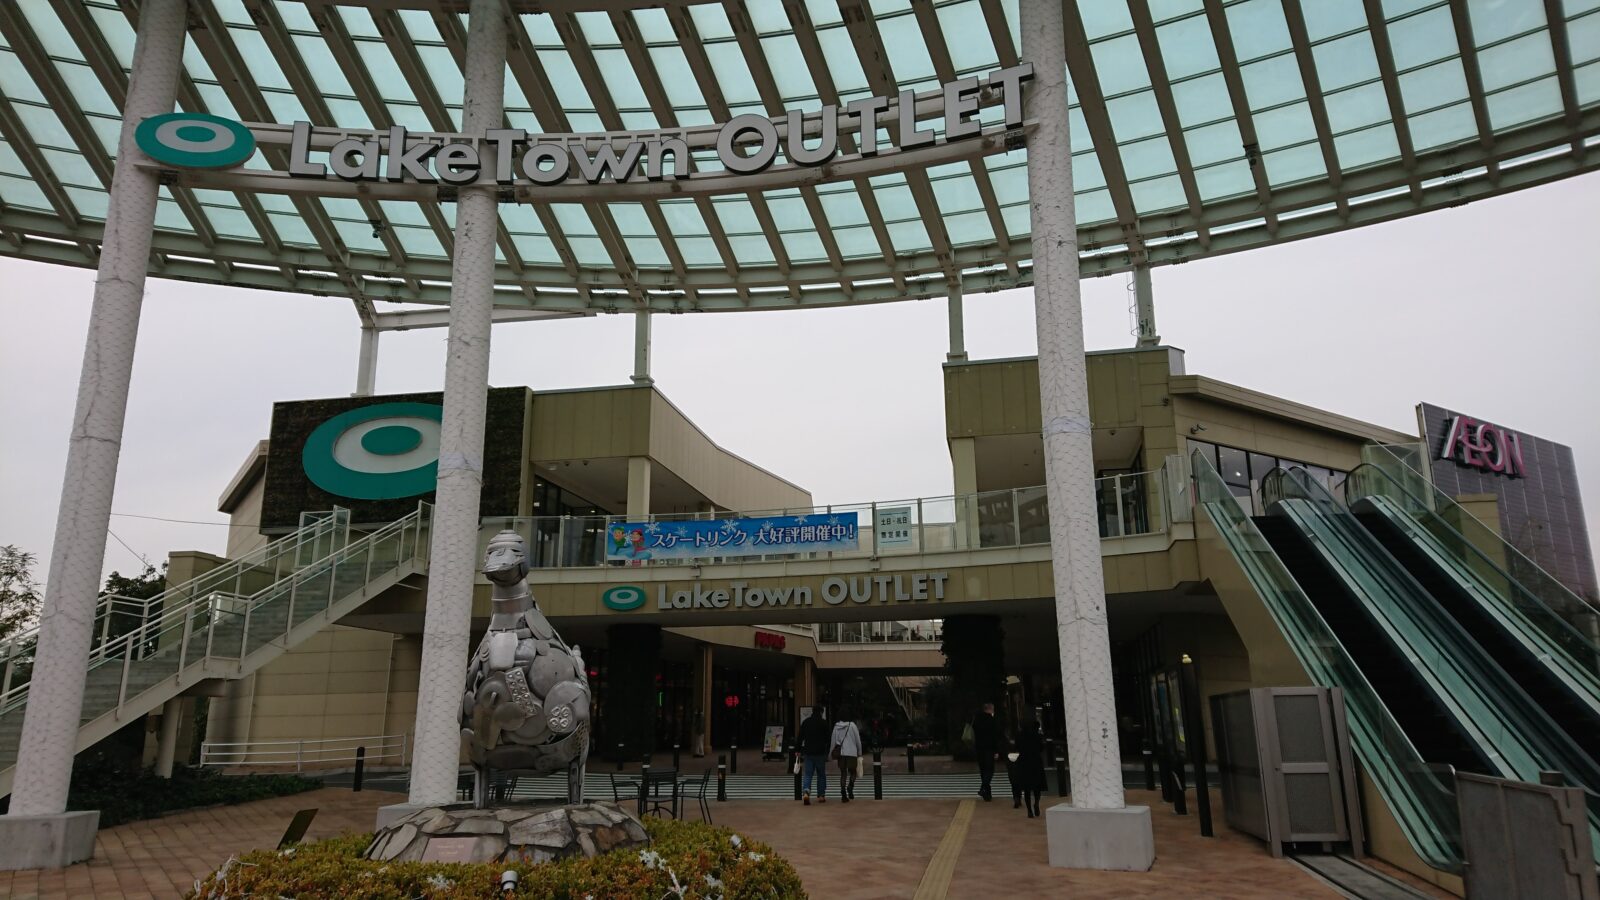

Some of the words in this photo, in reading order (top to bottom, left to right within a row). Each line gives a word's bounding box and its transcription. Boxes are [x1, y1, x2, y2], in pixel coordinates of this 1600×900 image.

[289, 121, 691, 186] LakeTown
[716, 62, 1035, 176] OUTLET
[651, 529, 749, 548] スケートリンク
[657, 581, 813, 611] LakeTown
[820, 571, 950, 605] OUTLET
